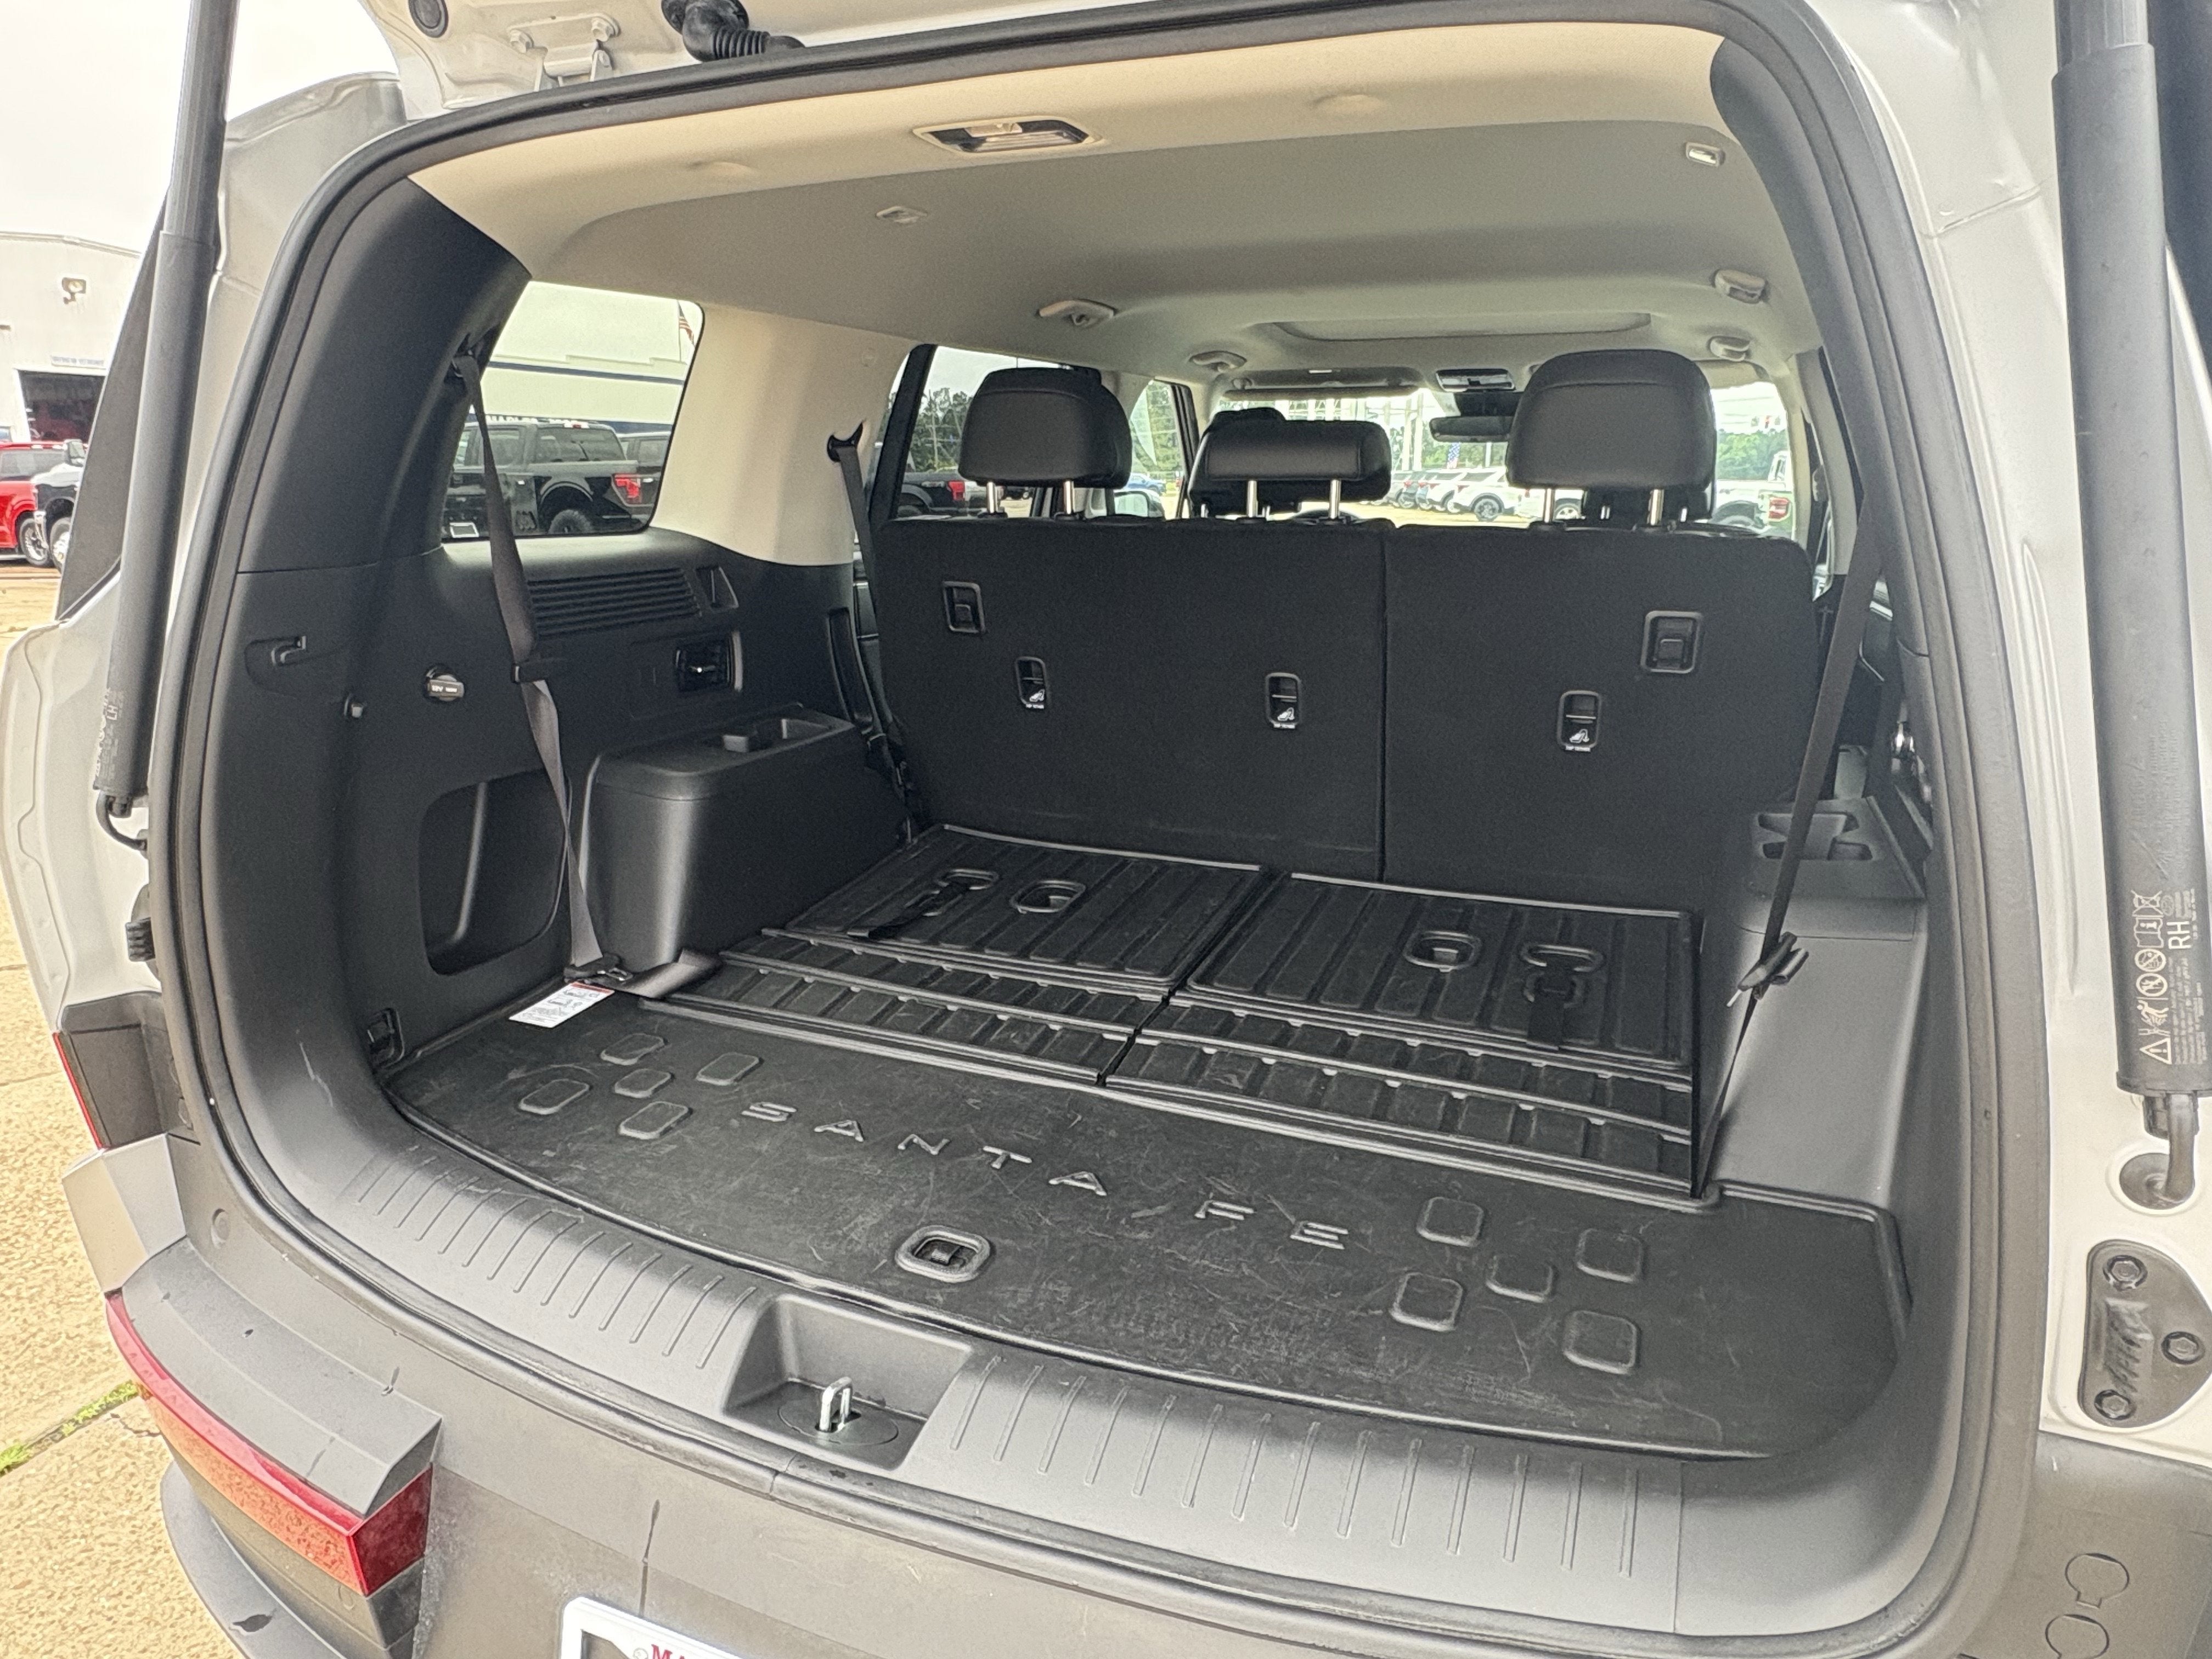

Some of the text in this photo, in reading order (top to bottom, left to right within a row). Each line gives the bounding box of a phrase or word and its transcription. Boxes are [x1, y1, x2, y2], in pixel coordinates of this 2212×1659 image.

[106, 706, 118, 720] LH
[2166, 921, 2191, 949] RH
[741, 1101, 1348, 1250] SANTA FE
